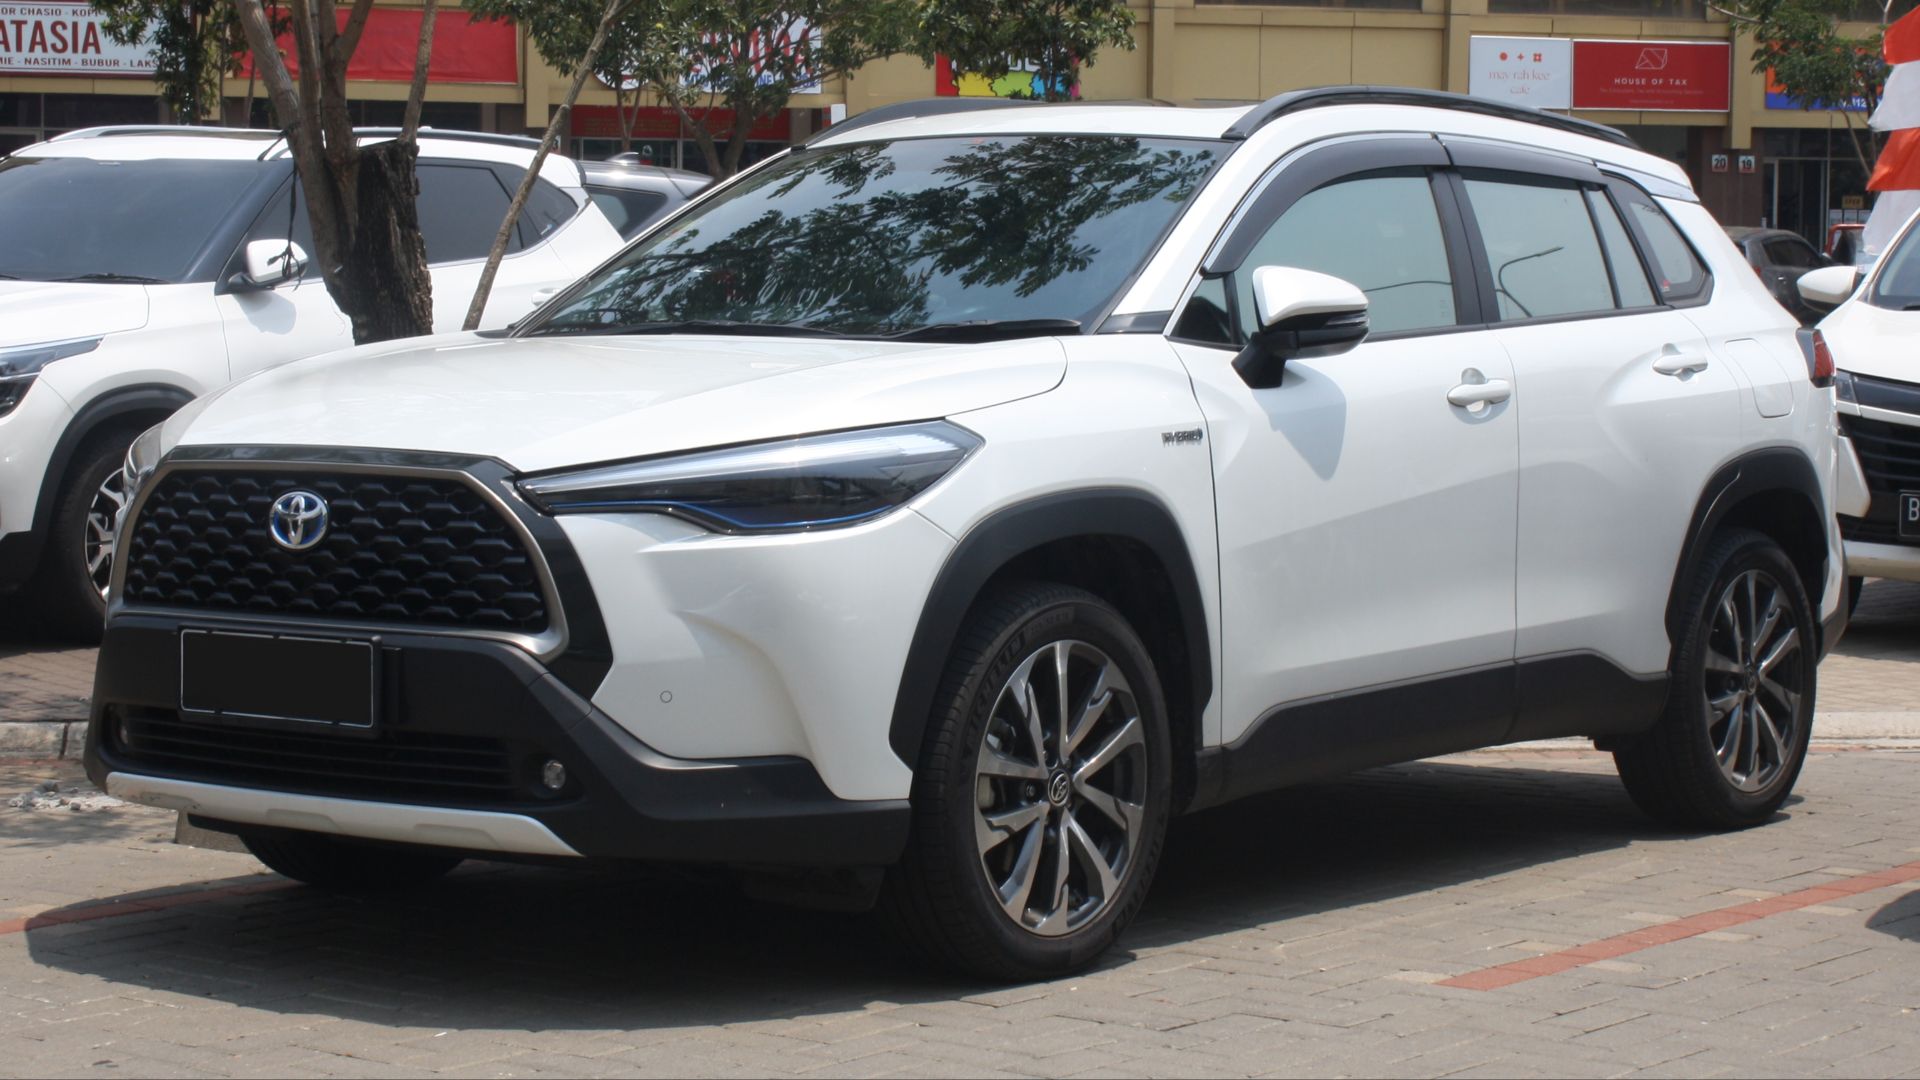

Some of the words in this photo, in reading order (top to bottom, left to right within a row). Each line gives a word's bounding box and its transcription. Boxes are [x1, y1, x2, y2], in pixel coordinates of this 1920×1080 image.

[20, 7, 62, 16] CHASIO
[24, 57, 71, 66] NASITIM
[81, 58, 120, 67] BUBUR
[130, 60, 160, 68] LAKS
[1614, 77, 1647, 85] HOUSE
[1651, 78, 1664, 86] OF
[1714, 157, 1727, 169] 20
[1741, 158, 1753, 170] 19
[1908, 497, 1920, 521] B
